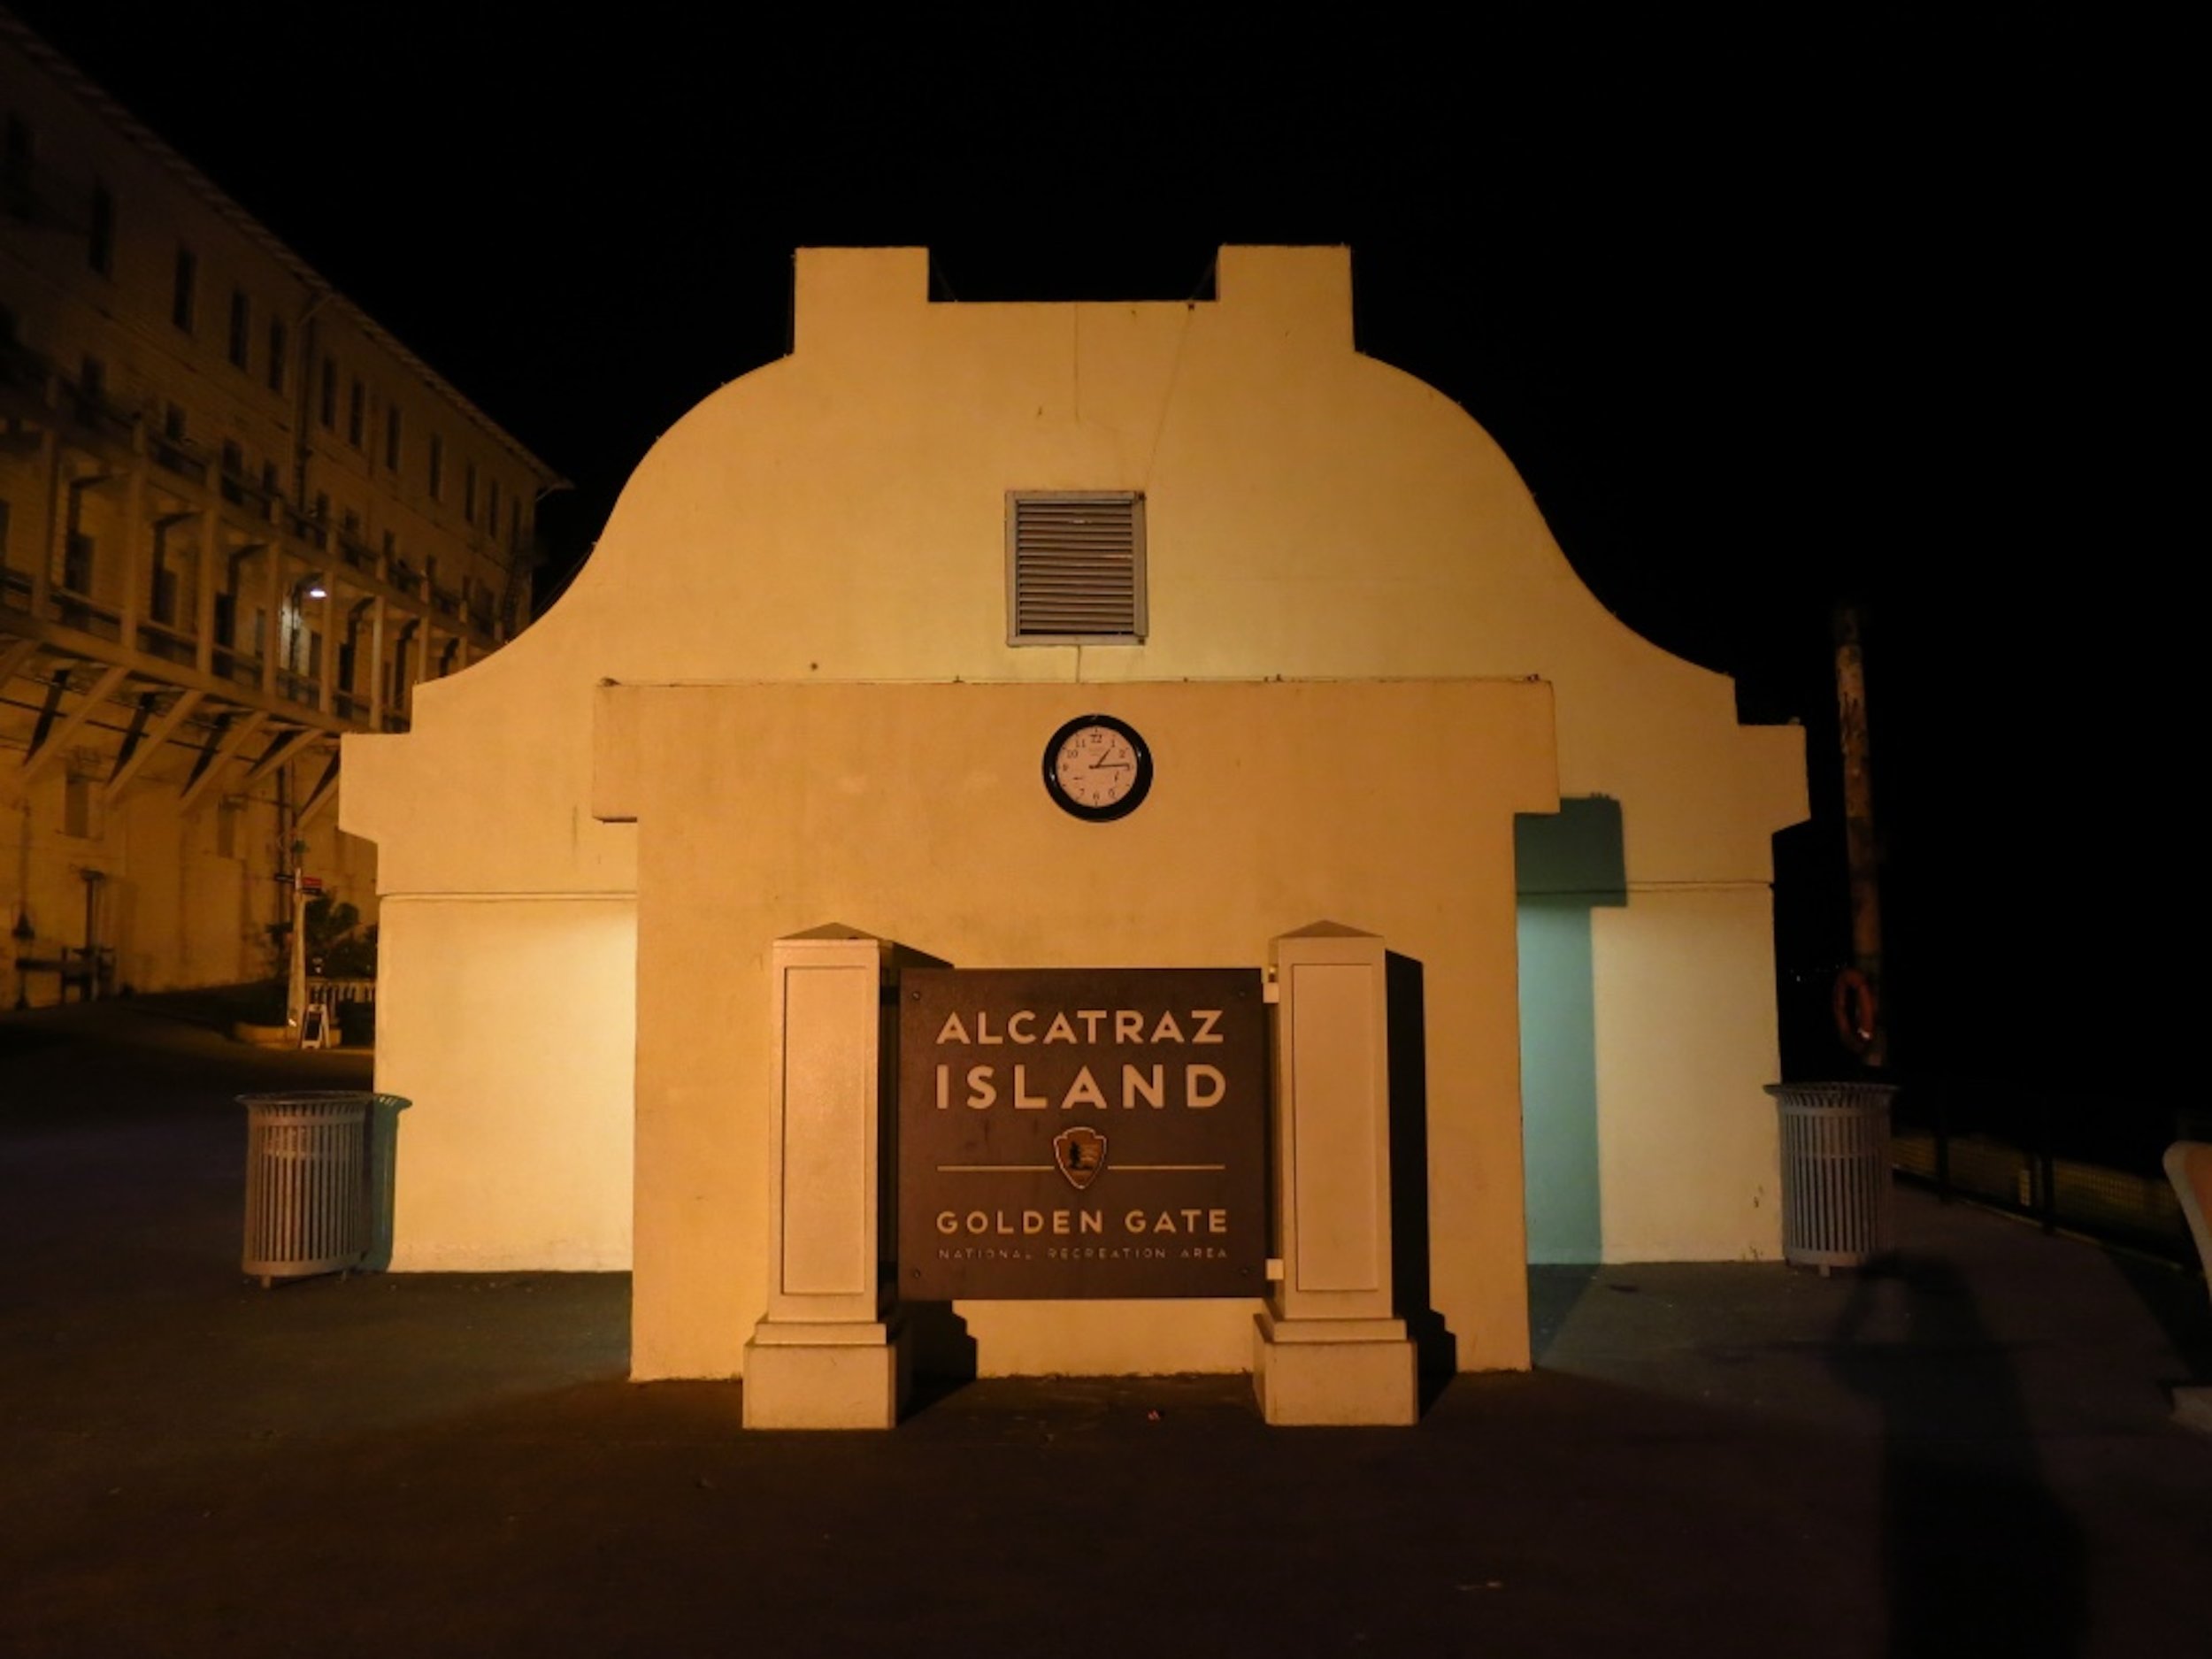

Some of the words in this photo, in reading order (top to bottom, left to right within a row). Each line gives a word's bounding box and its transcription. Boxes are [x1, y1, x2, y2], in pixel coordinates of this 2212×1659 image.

[935, 1010, 1225, 1045] ALCATRAZ
[935, 1064, 1226, 1110] ISLAND
[936, 1210, 1102, 1234] GOLDEN
[1124, 1209, 1228, 1234] GATE
[938, 1248, 1033, 1260] NATIONAL
[1048, 1247, 1167, 1260] RECREATION
[1179, 1247, 1228, 1259] AREA
